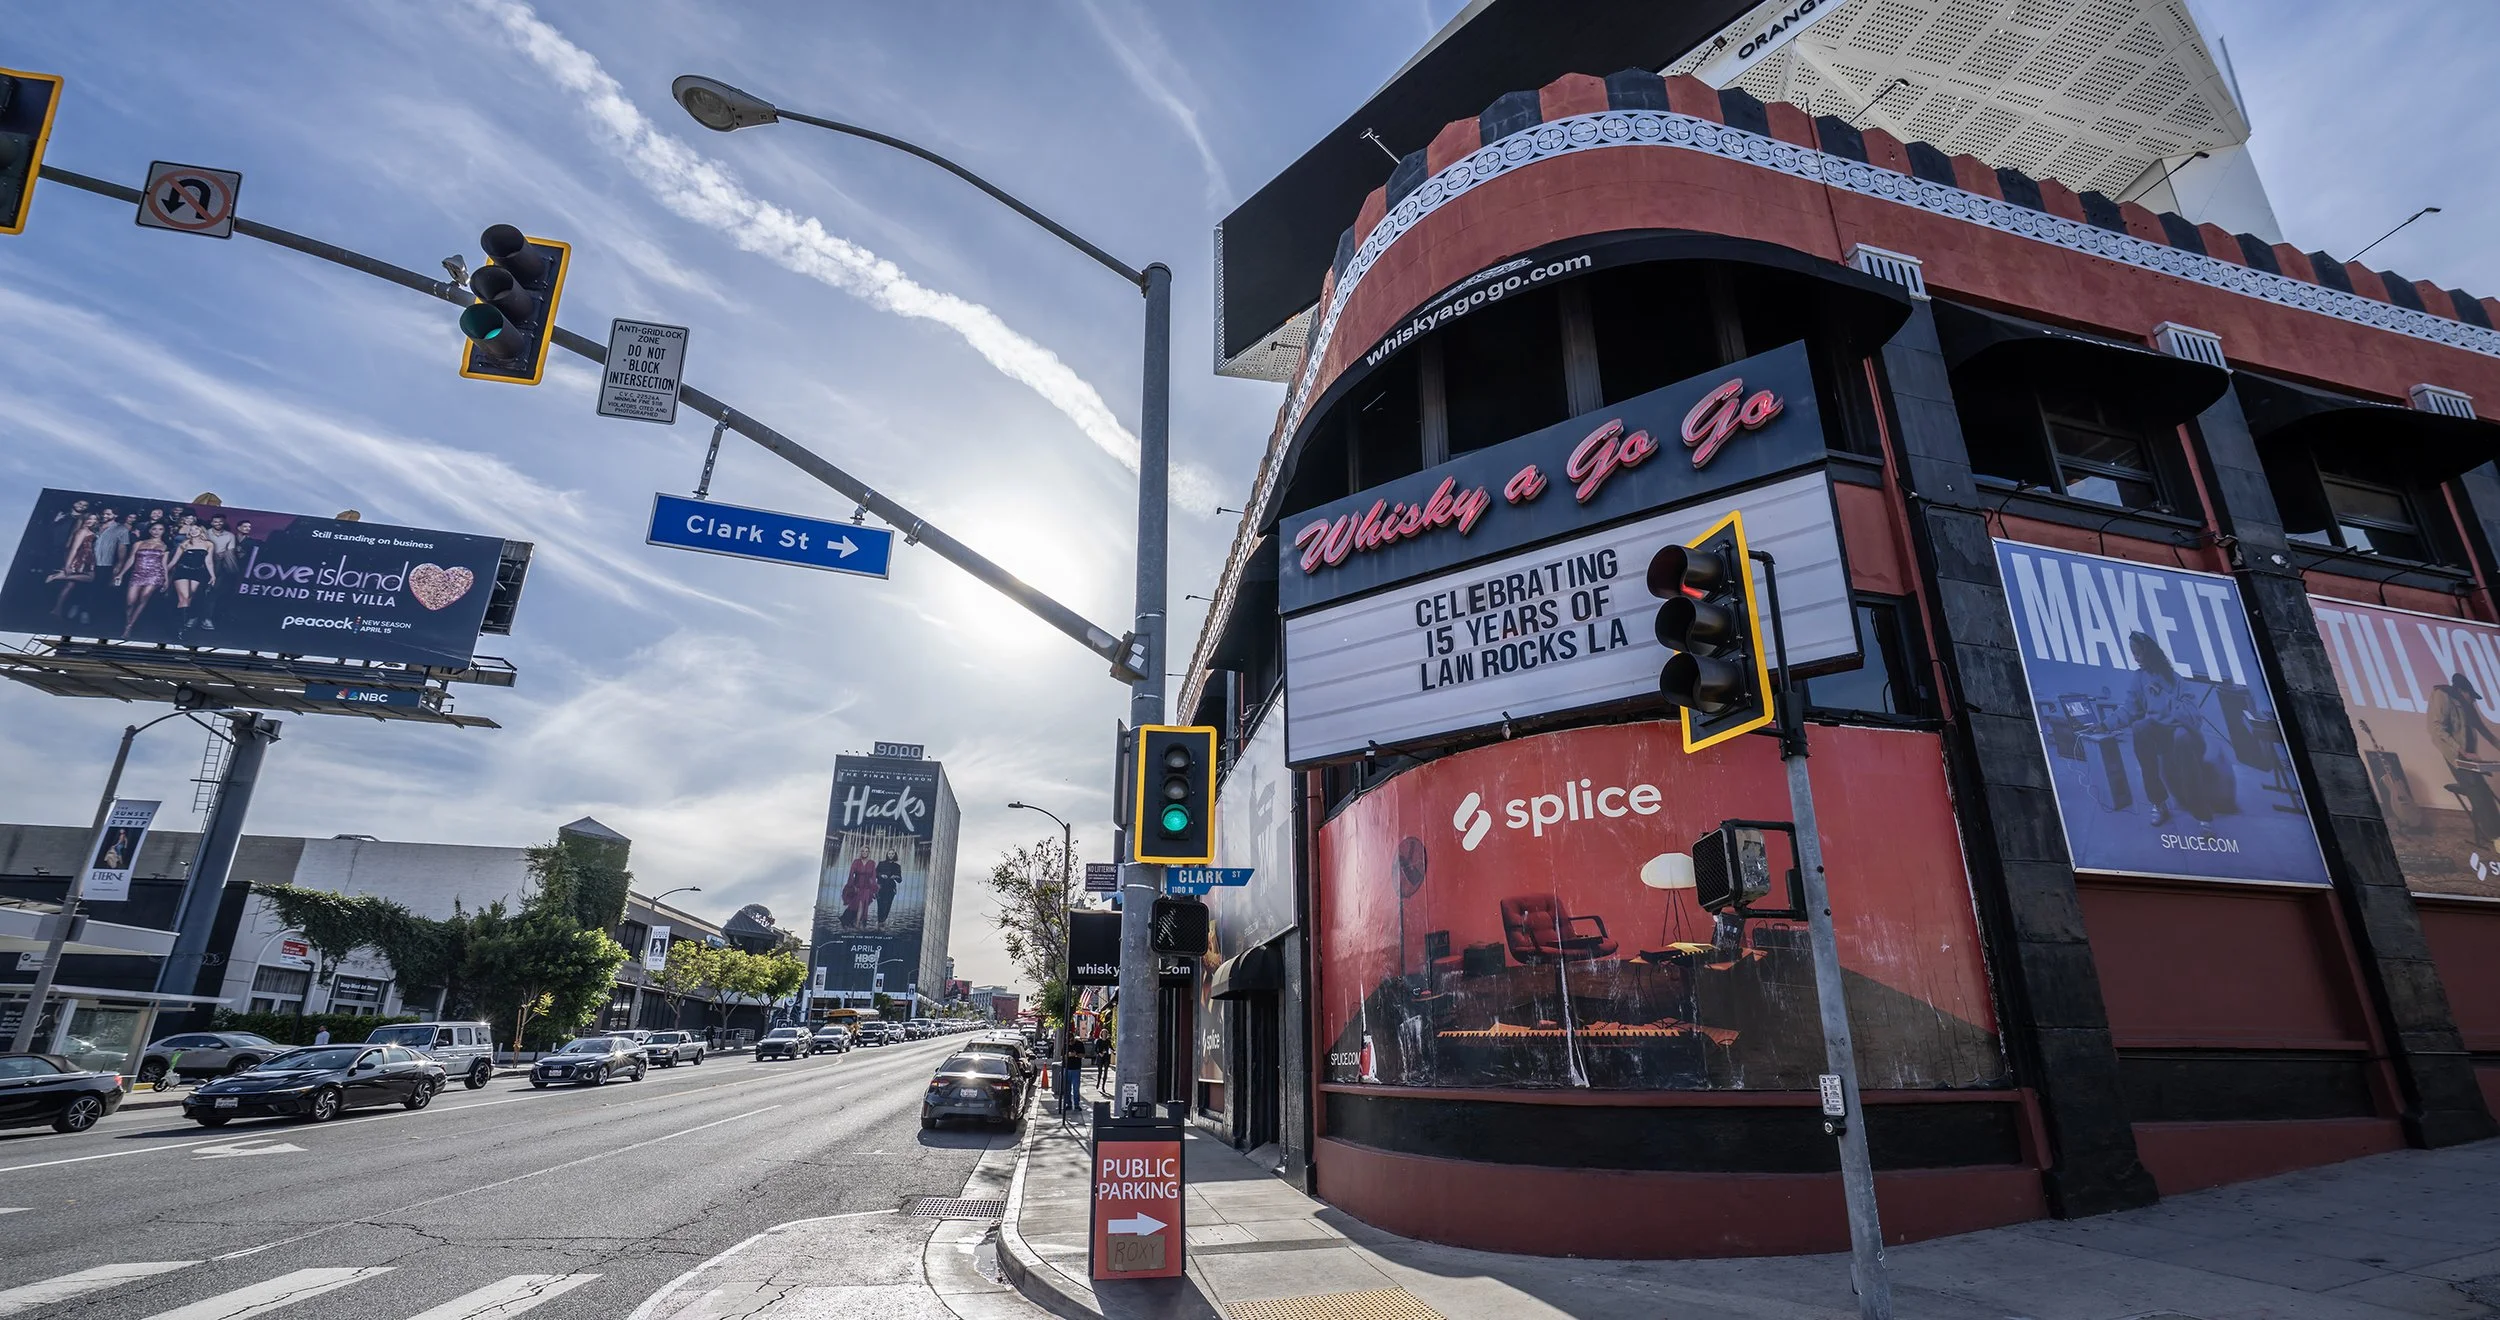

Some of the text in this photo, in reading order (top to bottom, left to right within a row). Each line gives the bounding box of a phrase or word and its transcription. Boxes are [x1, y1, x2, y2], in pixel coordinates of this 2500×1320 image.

[1738, 0, 1823, 59] ORANG
[1366, 254, 1592, 367] whiskyagogo.com
[617, 324, 684, 339] ANTI-GRIDLOCK
[638, 335, 660, 344] ZONE
[628, 344, 666, 360] DO NOT
[629, 359, 660, 374] BLOCK
[609, 371, 675, 391] INTERSECTION
[608, 401, 637, 410] VIOLATORS
[614, 407, 659, 417] PHOTOGRAPHED
[1295, 376, 1784, 575] Whisky a Go Go
[311, 529, 435, 550] Still standing on business
[686, 514, 810, 551] Clark St
[244, 546, 409, 592] love island
[239, 583, 396, 608] BEYOND THE VILLA
[1416, 549, 1618, 628] CELEBRATING
[281, 615, 353, 630] peacock
[380, 620, 411, 629] SEASON
[1426, 585, 1609, 658] 15 YEARS OF
[2010, 552, 2247, 686] MAKE IT
[360, 626, 383, 634] APRIL
[1421, 618, 1629, 691] LAW ROCKS LA
[2314, 607, 2429, 714] TILL
[359, 692, 388, 703] NBC
[876, 744, 921, 758] 9000
[842, 785, 926, 831] Hacks
[1505, 778, 1663, 837] splice
[2160, 834, 2240, 853] SPLICE.COM
[1087, 865, 1117, 873] NO LITTERING
[1178, 869, 1241, 884] CLARK ST
[1171, 886, 1194, 894] 1100 N
[850, 944, 874, 952] APRIL
[855, 953, 876, 963] HBO
[1103, 1158, 1175, 1178] PUBLIC
[1099, 1182, 1178, 1200] PARKING
[1115, 1241, 1158, 1264] ROXY
